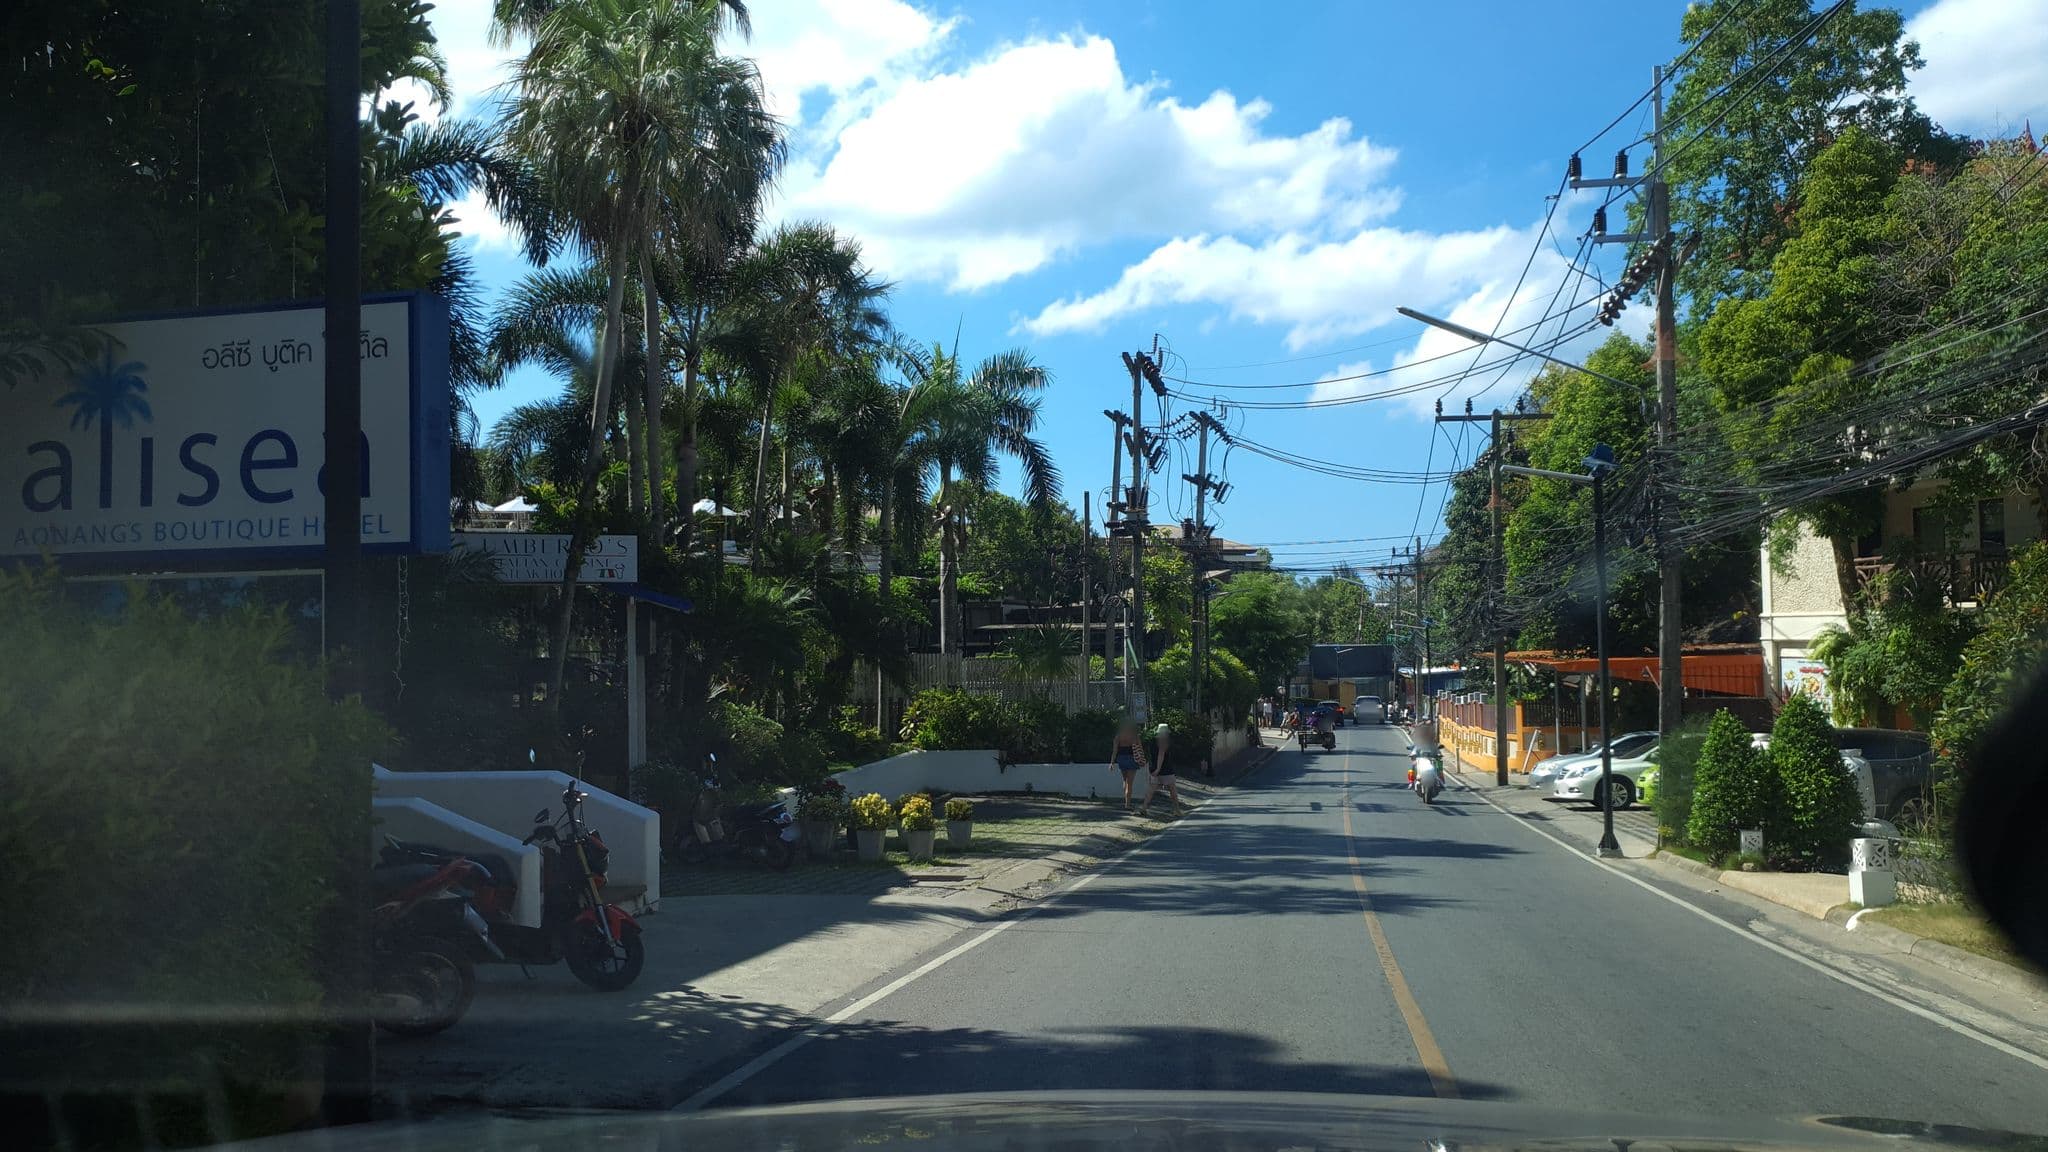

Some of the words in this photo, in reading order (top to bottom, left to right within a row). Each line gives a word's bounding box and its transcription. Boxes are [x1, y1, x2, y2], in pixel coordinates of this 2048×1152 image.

[202, 339, 252, 369] อลีซี
[262, 338, 313, 372] บูติค
[154, 516, 290, 543] BOUTIQUE
[304, 513, 391, 538] HEL
[482, 538, 628, 555] UMBERO'S
[497, 558, 550, 568] TALIAN
[555, 558, 609, 568] CSINE
[545, 568, 585, 580] HOE
